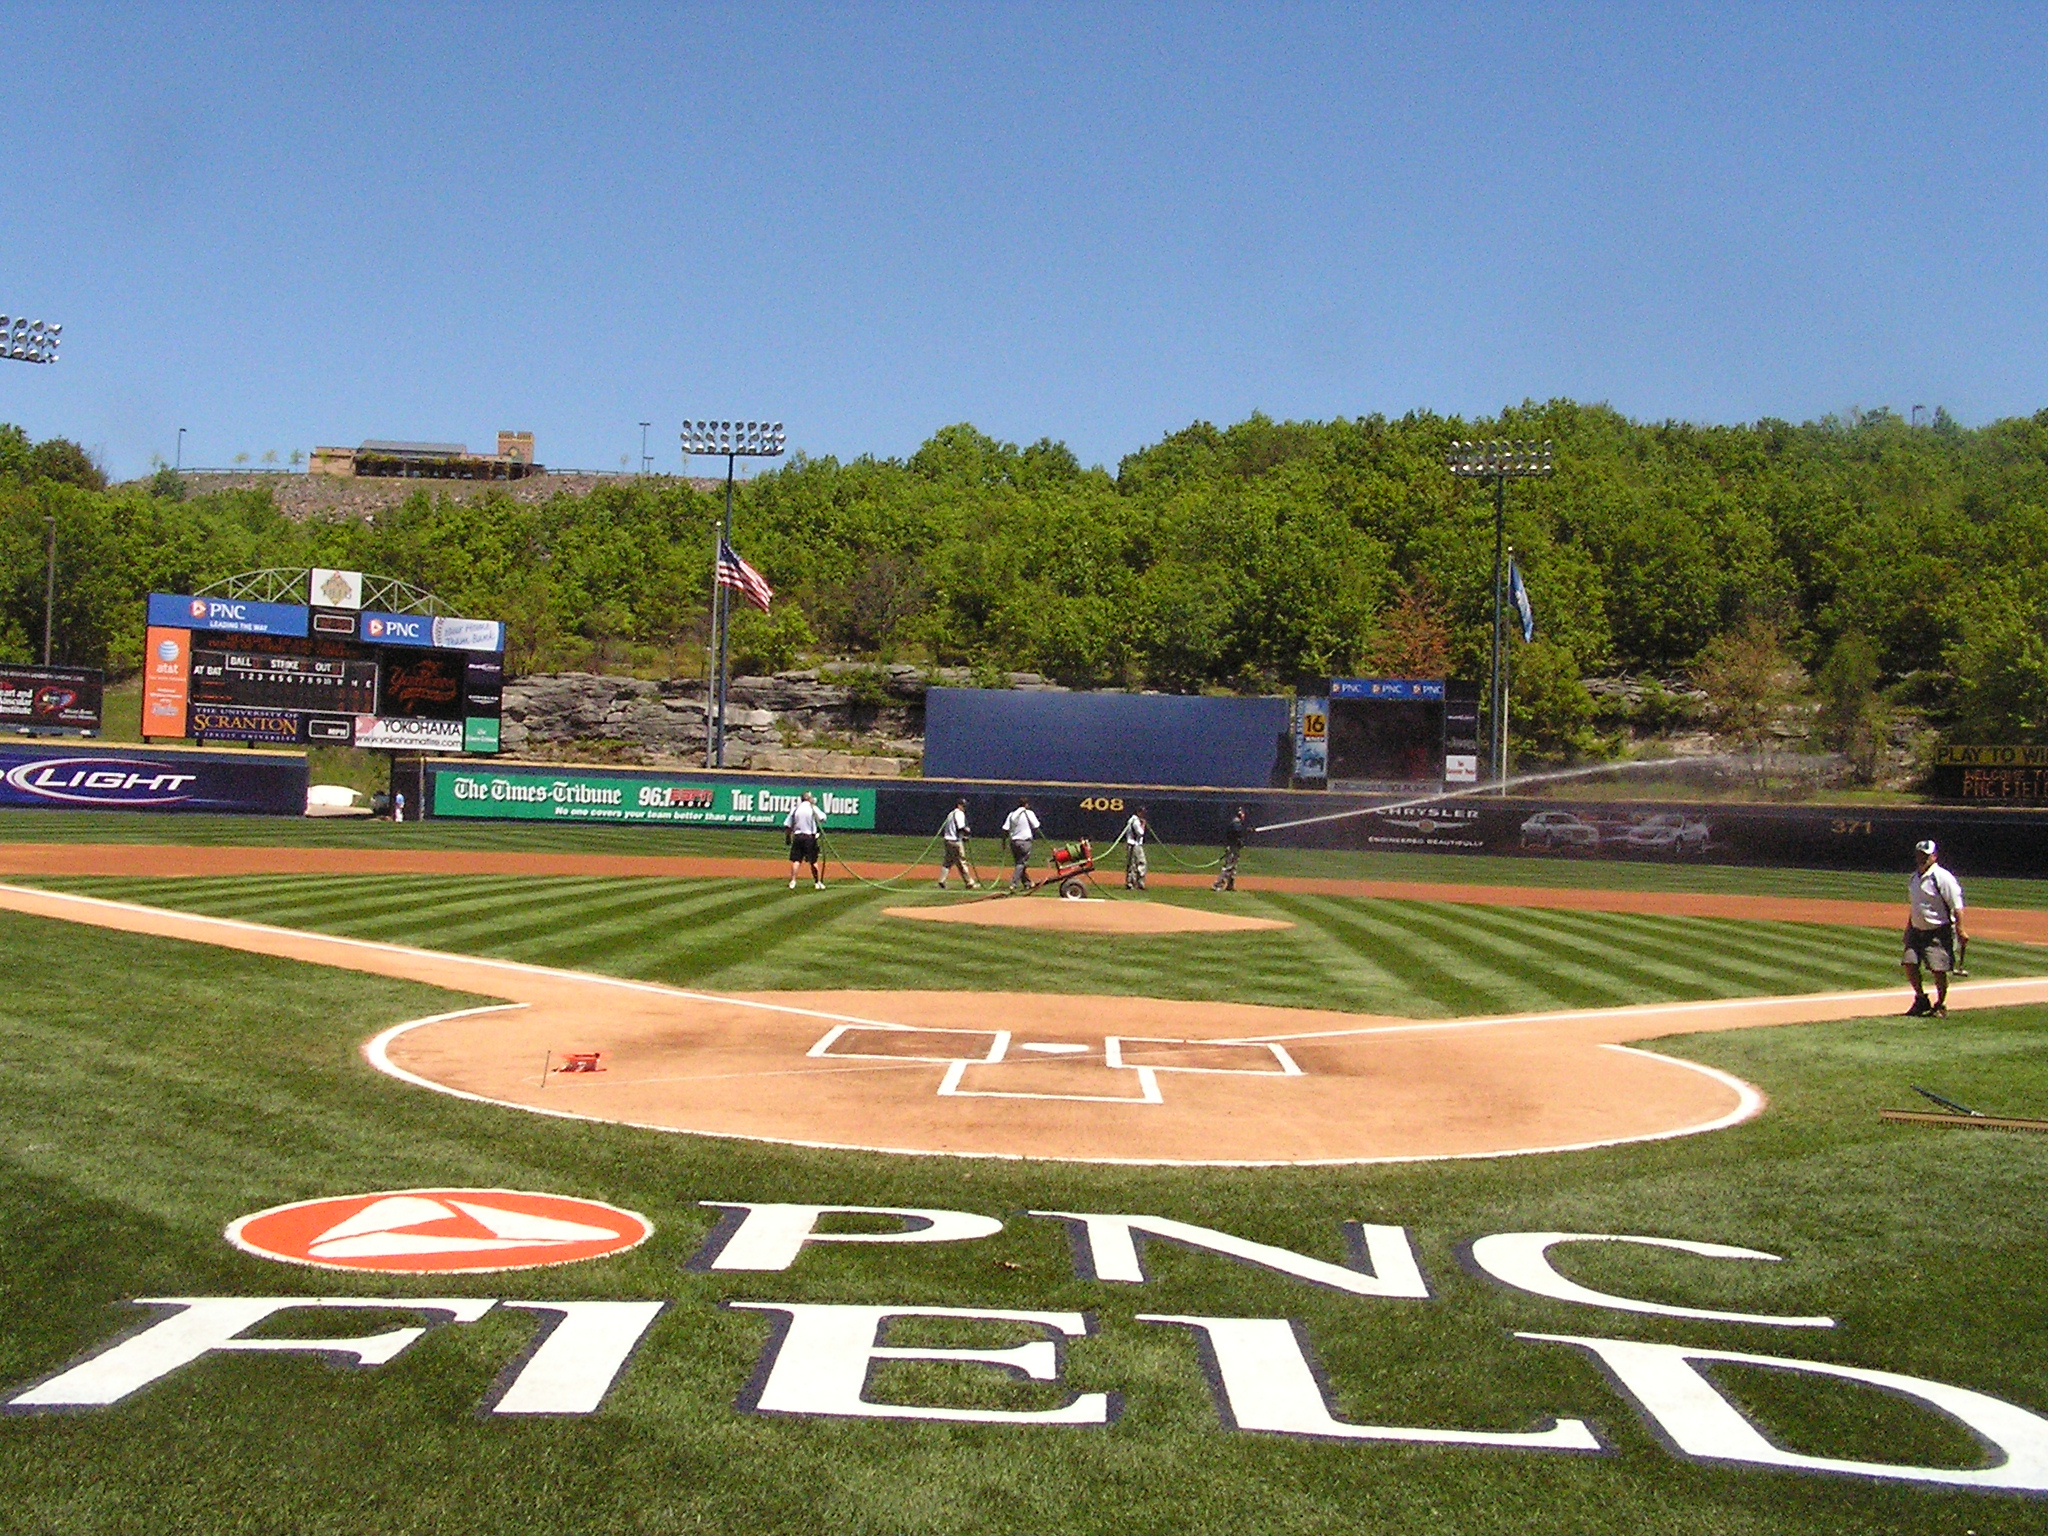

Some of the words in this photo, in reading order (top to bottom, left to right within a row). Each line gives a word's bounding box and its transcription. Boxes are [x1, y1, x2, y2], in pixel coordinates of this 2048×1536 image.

[209, 603, 246, 620] PNC
[210, 620, 238, 629] LEADING
[240, 622, 252, 631] THE
[253, 624, 268, 632] WAY
[386, 621, 419, 638] PNC
[193, 665, 205, 675] AT
[206, 666, 222, 676] BAT
[230, 656, 252, 667] BALL
[271, 659, 299, 670] STRIKE
[315, 663, 332, 672] OUT
[240, 672, 245, 680] 1
[257, 673, 263, 681] 3
[269, 674, 275, 682] 4
[278, 674, 284, 682] 5
[286, 675, 293, 683] 6
[306, 676, 313, 684] 8
[323, 677, 332, 685] 10
[17, 689, 33, 698] and
[1341, 683, 1361, 693] PNC
[1382, 684, 1402, 694] PNC
[1422, 685, 1441, 694] PNC
[220, 708, 282, 718] UNIVERSITY
[193, 714, 297, 735] SCRANTON
[383, 719, 461, 736] YOKOHAMA
[1305, 715, 1325, 733] 16
[1939, 747, 1983, 762] PLAY
[1992, 747, 2016, 762] TO
[35, 768, 196, 791] LIGHT
[453, 777, 488, 801] The
[490, 778, 622, 805] Times-Tribune
[638, 786, 671, 807] 96.1
[1079, 797, 1124, 812] 408
[555, 807, 568, 816] No
[570, 809, 588, 817] one
[590, 809, 622, 818] covers
[624, 810, 645, 820] your
[647, 810, 672, 819] team
[674, 810, 703, 821] better
[705, 811, 726, 822] than
[728, 813, 746, 822] our
[747, 813, 774, 823] team!
[1376, 807, 1479, 819] CHRYSLER
[1831, 820, 1873, 834] 371
[697, 1200, 1838, 1328] PNC
[6, 1296, 2048, 1492] FIELD
